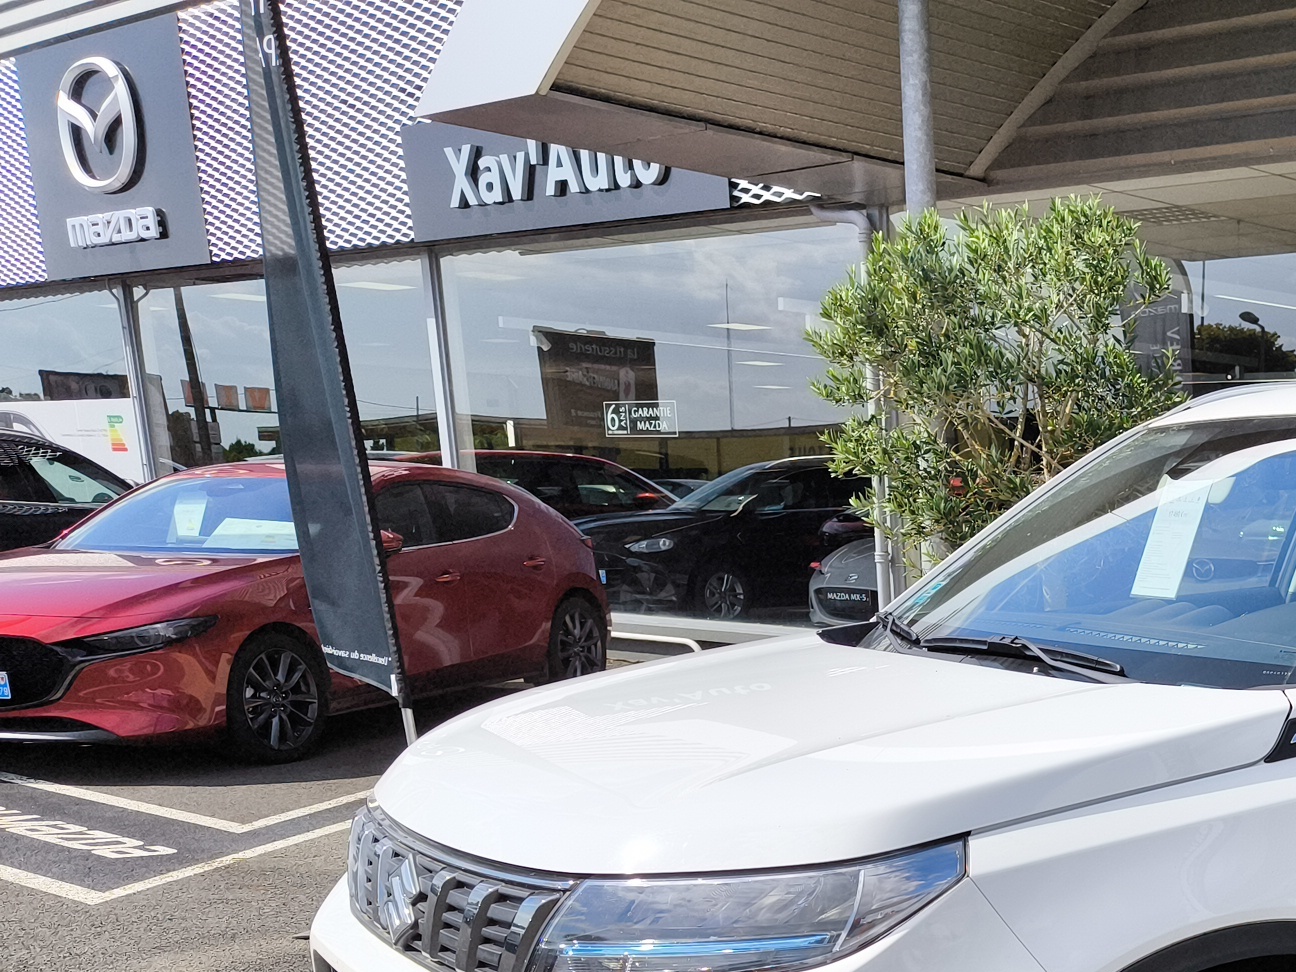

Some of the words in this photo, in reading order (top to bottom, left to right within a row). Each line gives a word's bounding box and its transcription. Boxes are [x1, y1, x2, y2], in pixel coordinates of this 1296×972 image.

[443, 139, 668, 209] Xav'Auto
[607, 404, 619, 431] 6
[619, 406, 628, 428] ANS
[631, 407, 672, 418] GARANTIE
[637, 420, 669, 431] MAZDA
[827, 592, 850, 600] MAZDA
